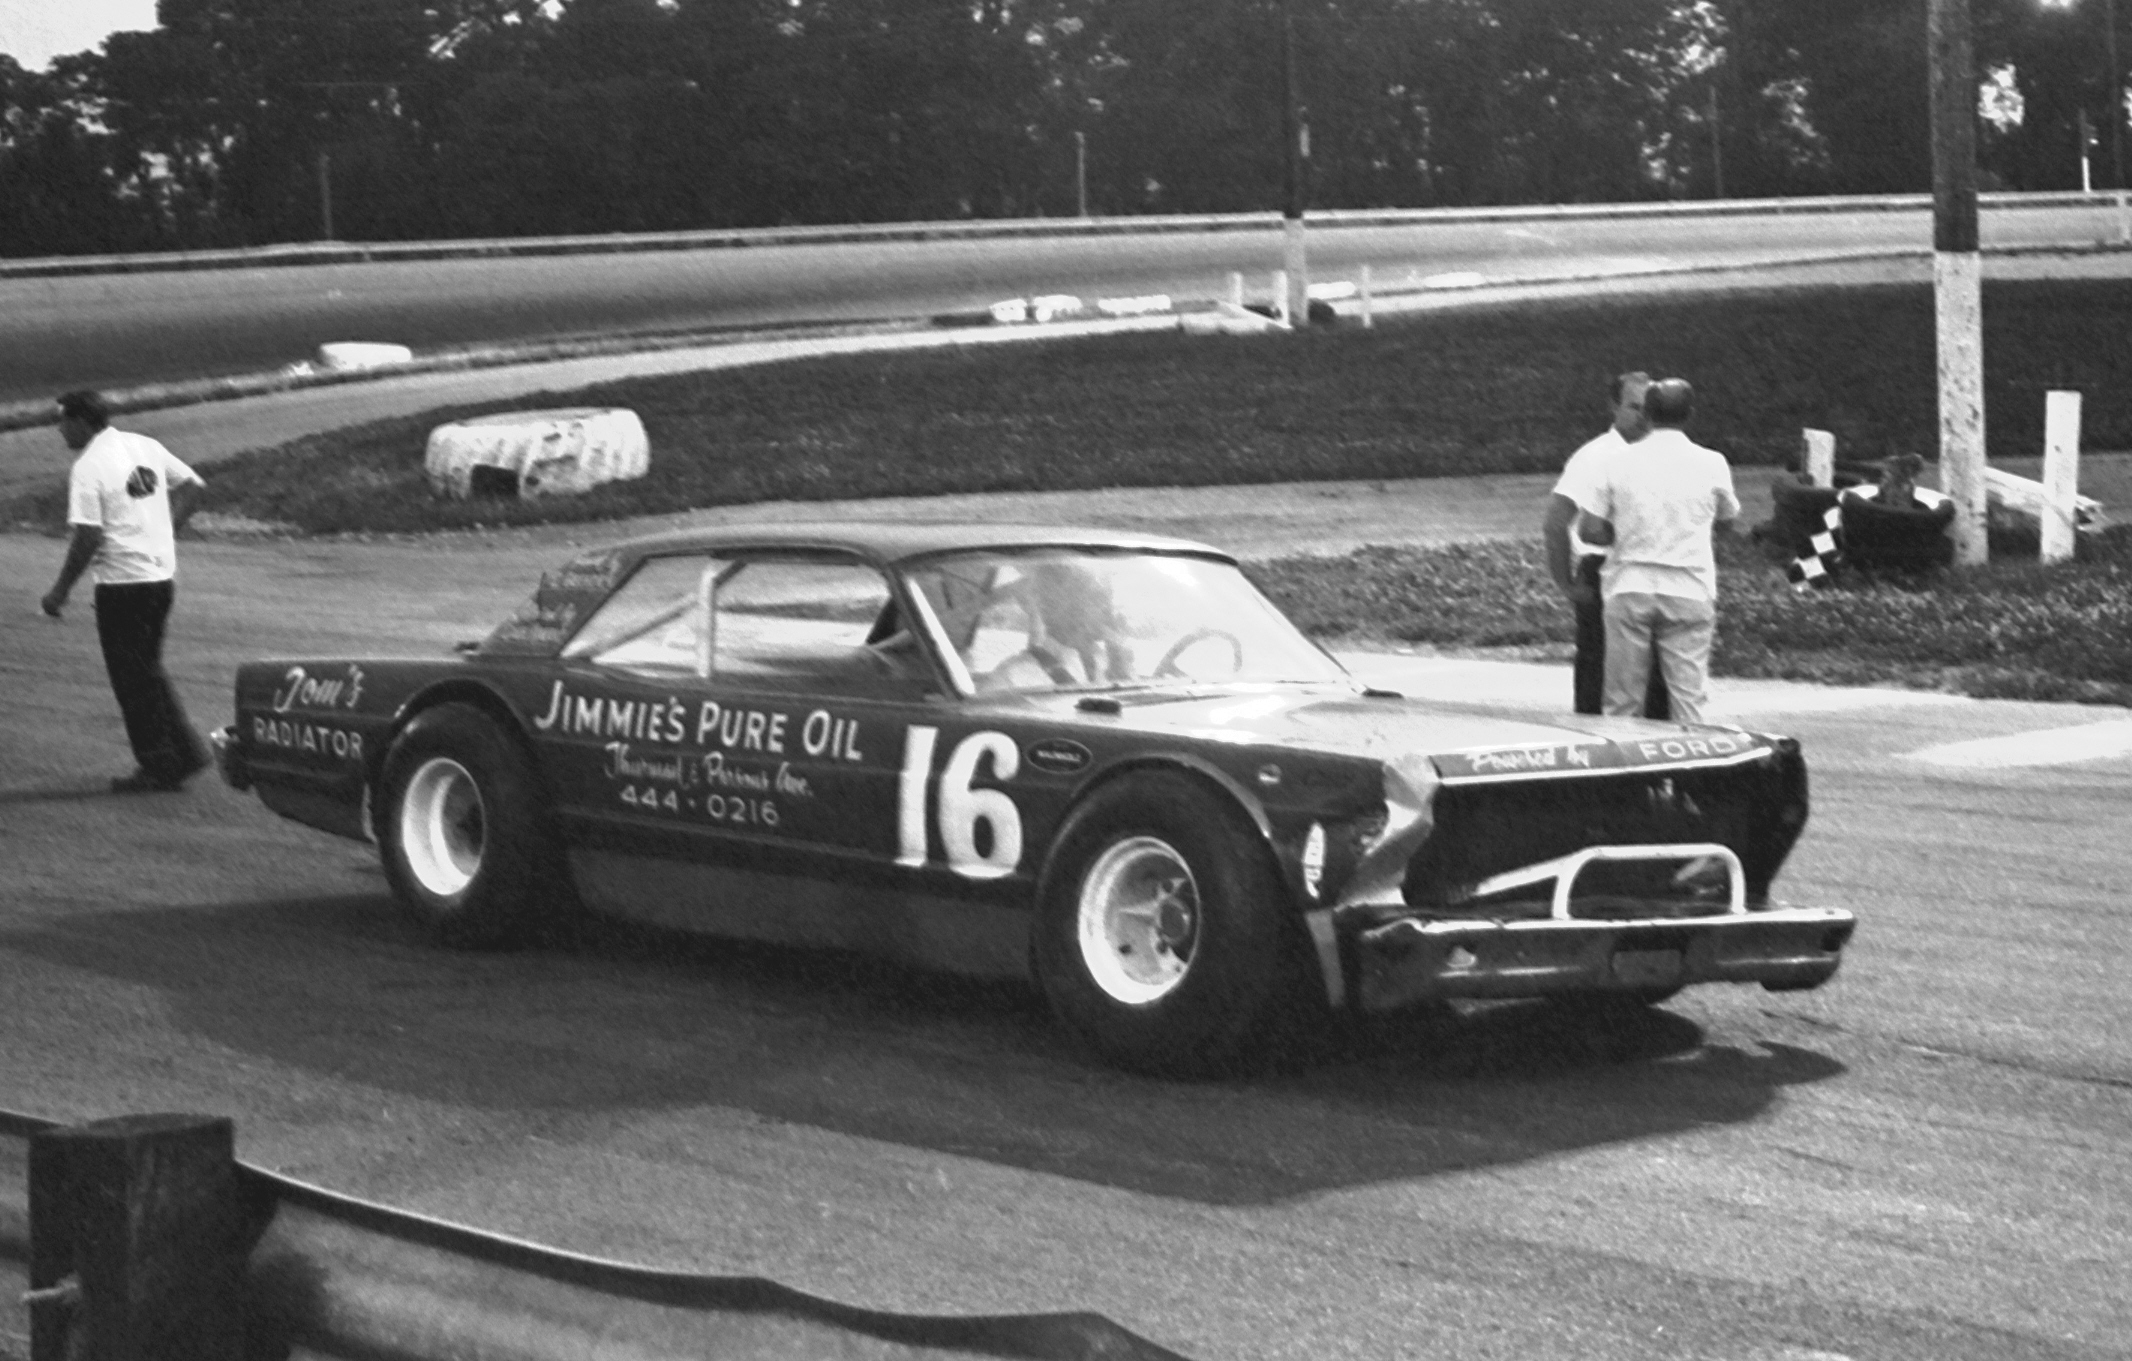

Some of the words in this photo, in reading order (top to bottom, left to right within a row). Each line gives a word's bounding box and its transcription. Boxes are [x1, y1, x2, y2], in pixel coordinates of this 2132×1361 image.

[253, 717, 363, 758] RADIATOR
[534, 680, 687, 742] JIMMIE'S
[697, 701, 788, 753] PURE
[802, 709, 863, 761] OIL
[1639, 735, 1737, 760] FORD
[893, 724, 1023, 880] 16
